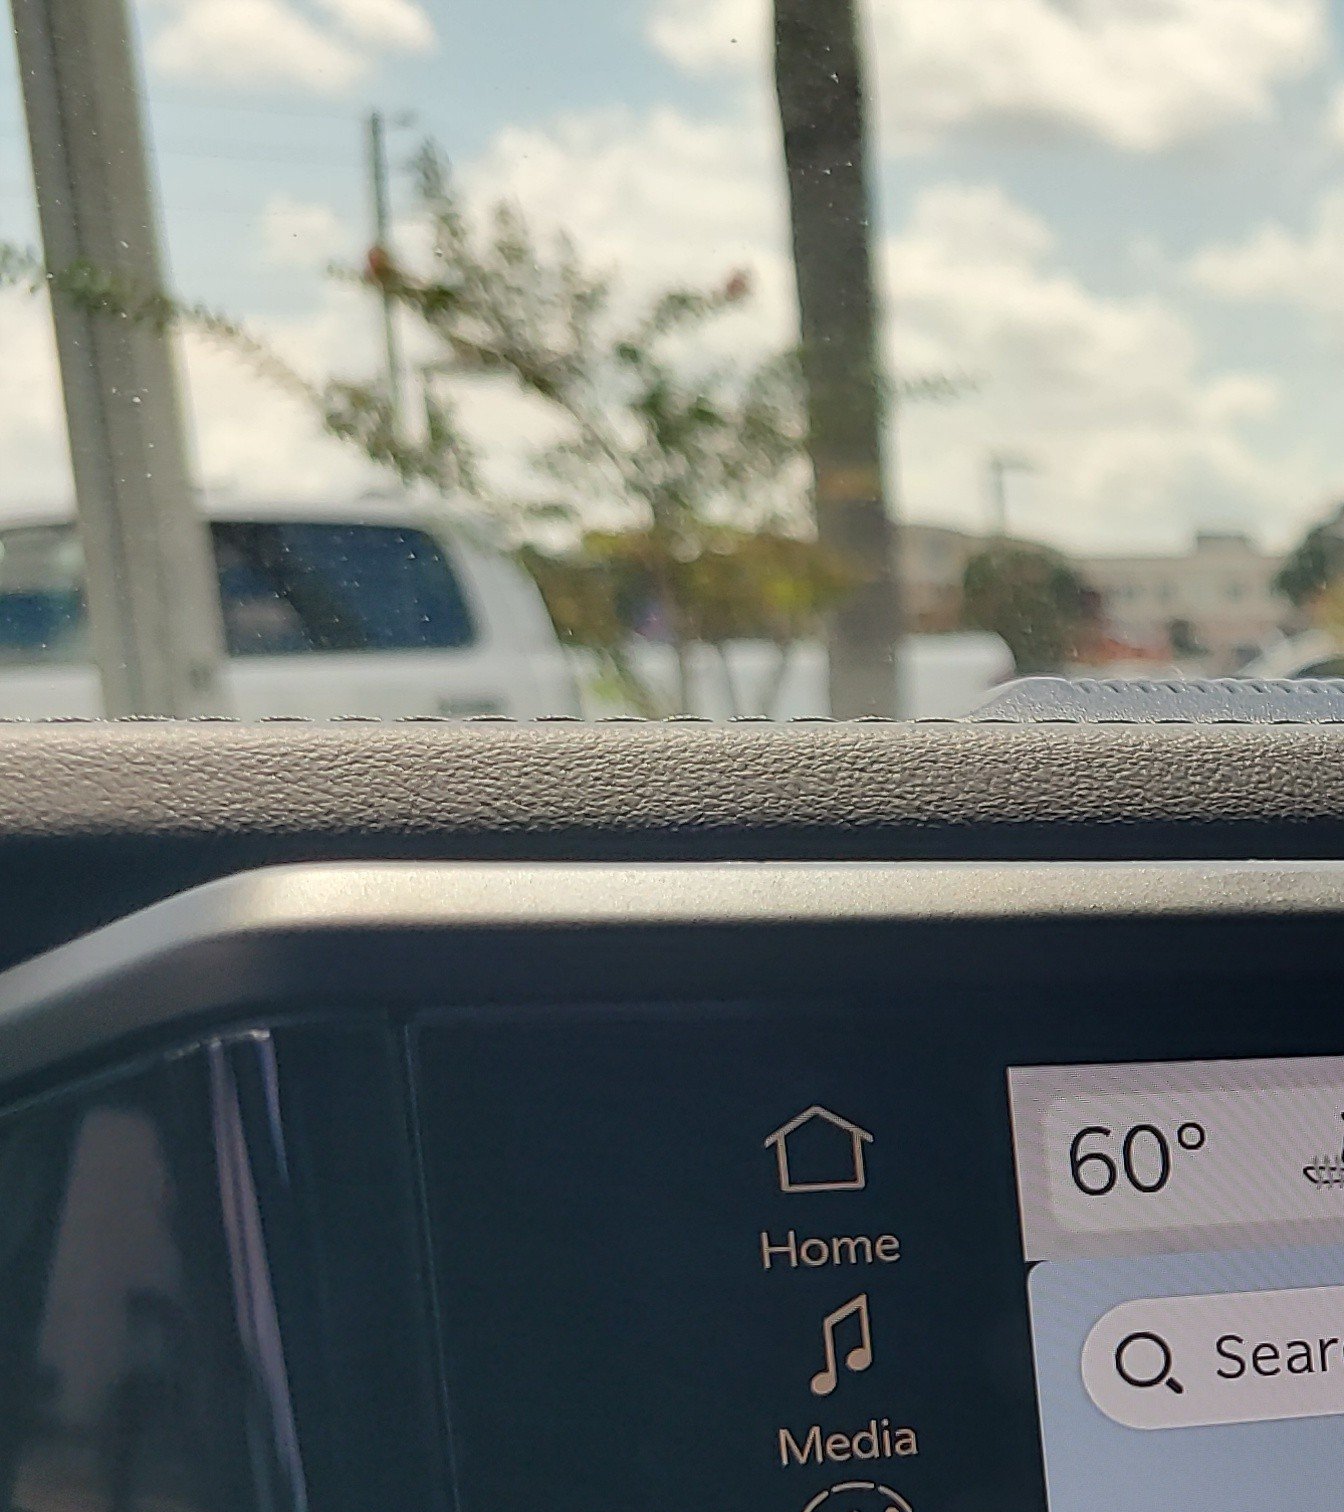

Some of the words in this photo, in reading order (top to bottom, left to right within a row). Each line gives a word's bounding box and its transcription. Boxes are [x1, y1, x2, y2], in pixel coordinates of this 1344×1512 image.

[1068, 1120, 1206, 1196] 60°
[758, 1229, 900, 1270] Home
[777, 1418, 919, 1467] Media
